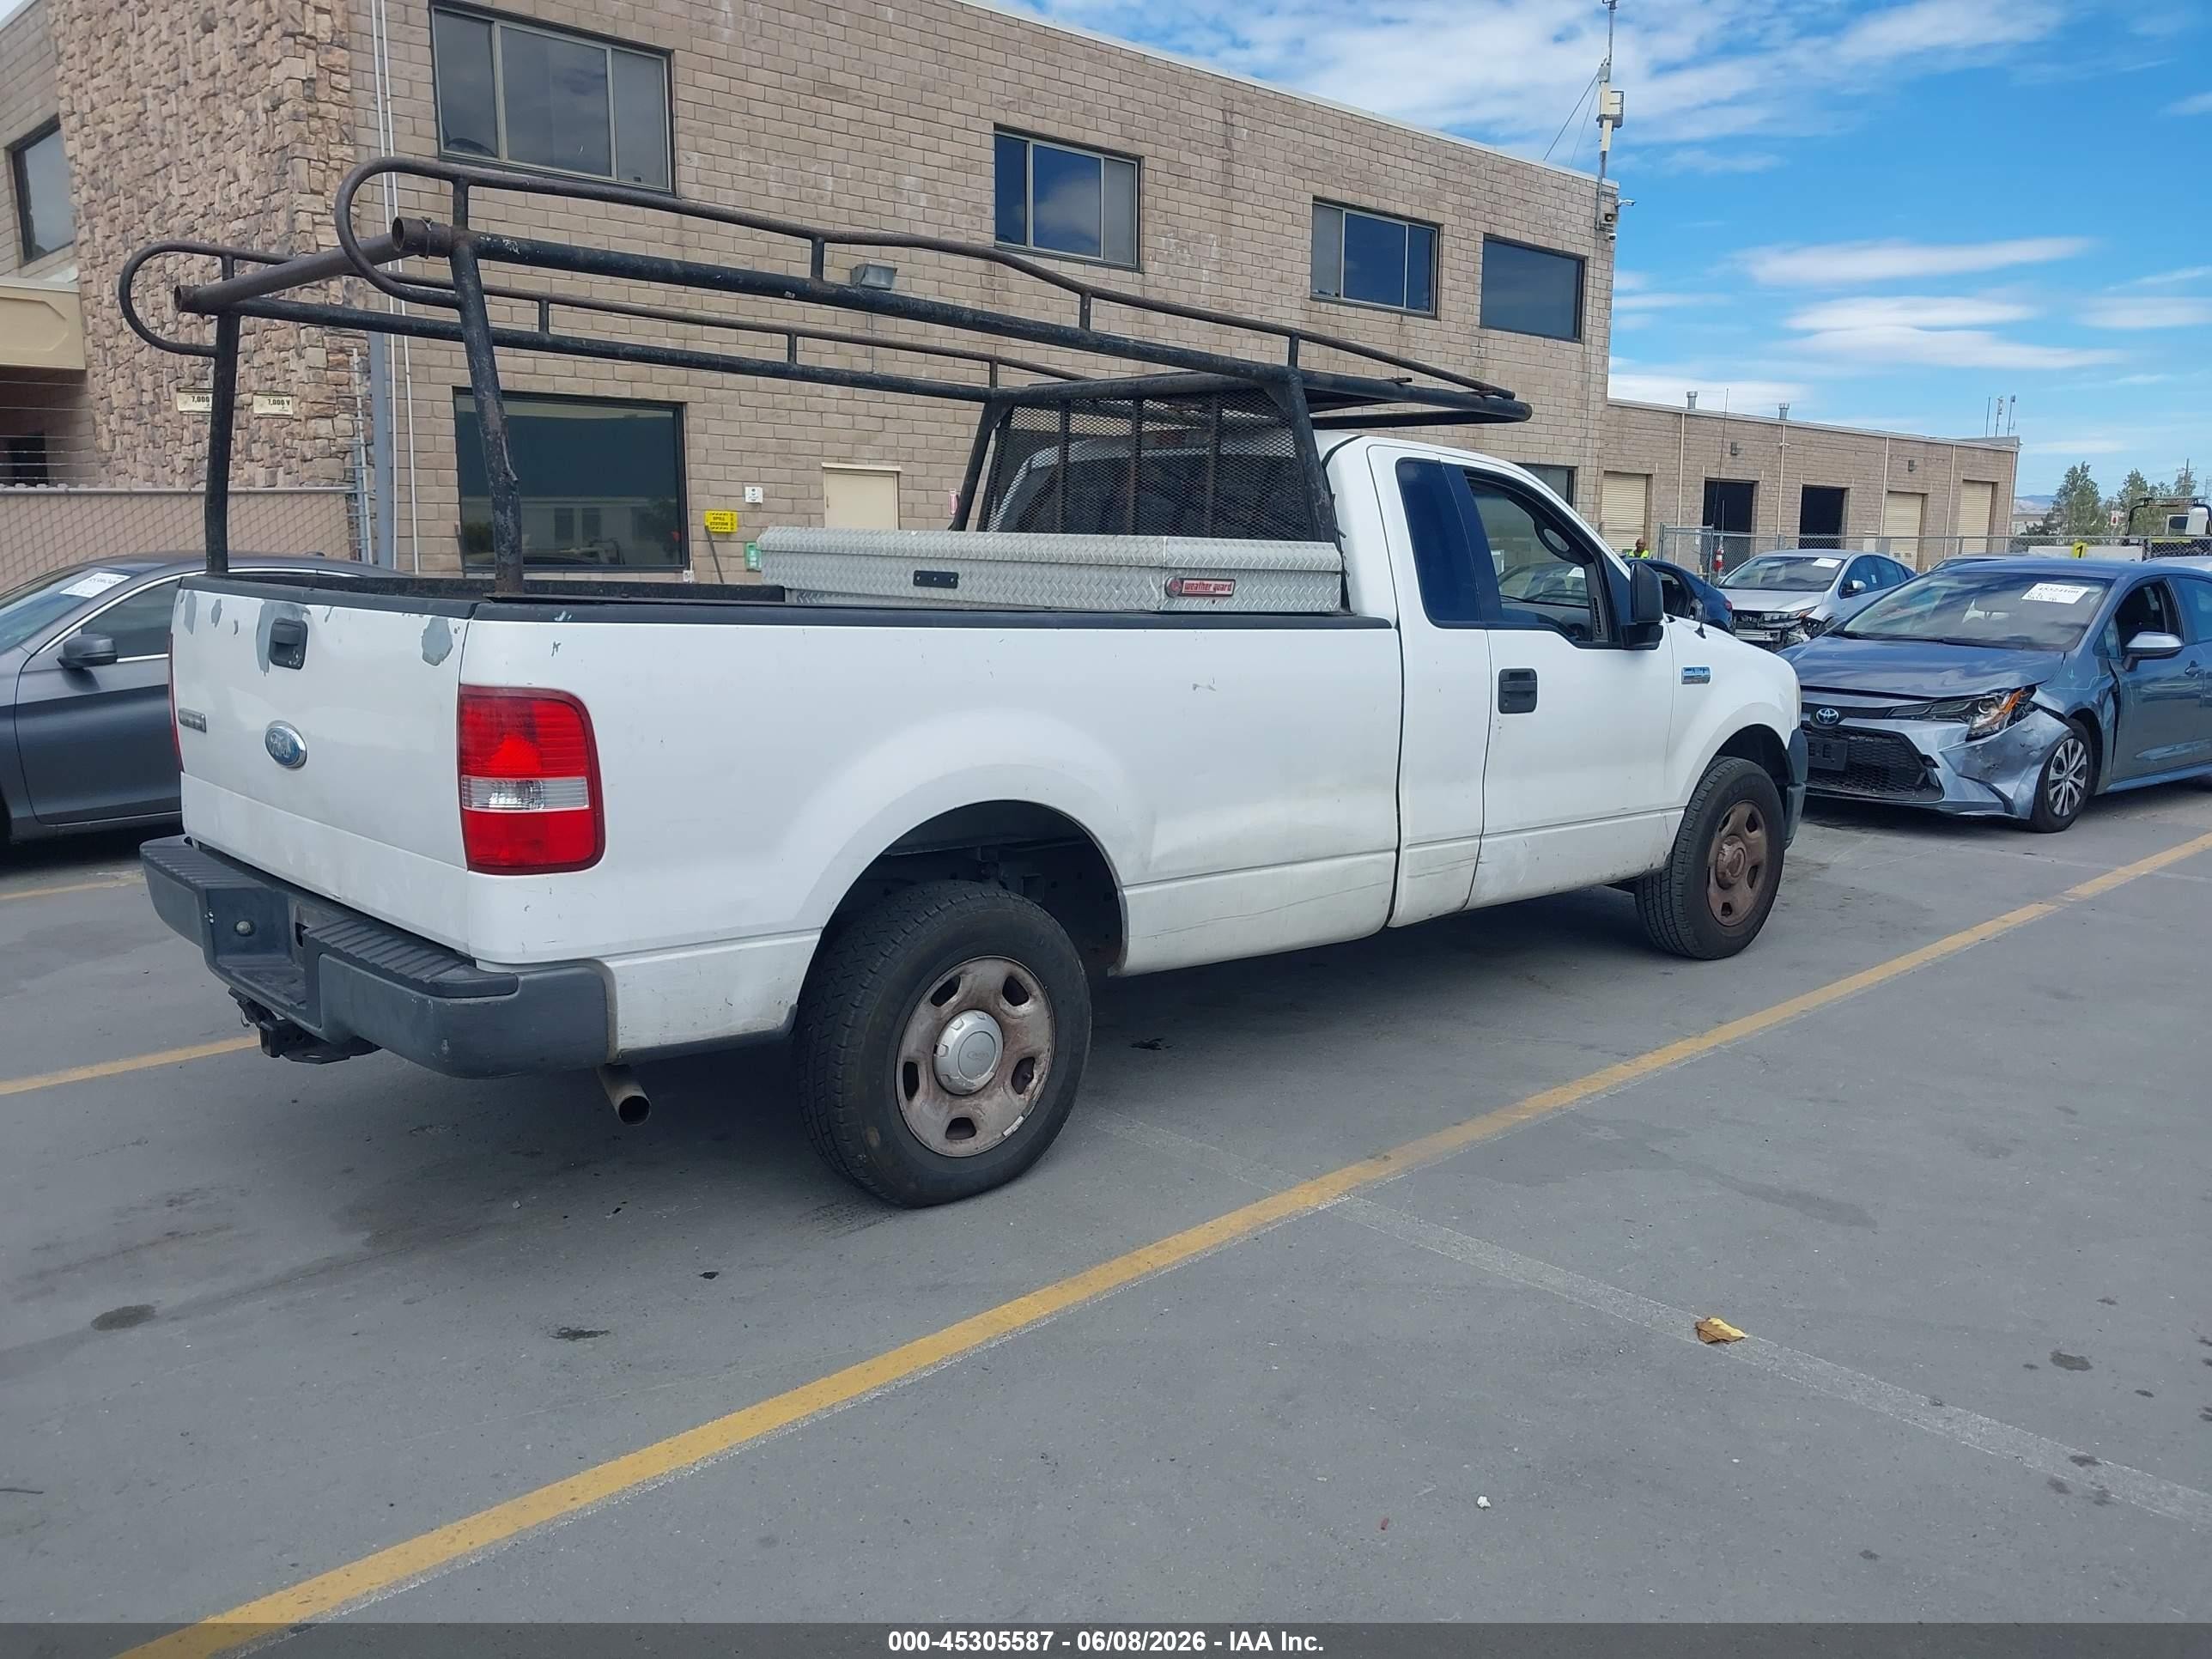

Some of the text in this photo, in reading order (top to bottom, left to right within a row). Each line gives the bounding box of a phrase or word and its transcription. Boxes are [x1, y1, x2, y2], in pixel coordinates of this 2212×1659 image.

[2075, 544, 2083, 558] 1
[1184, 581, 1233, 592] weather guard
